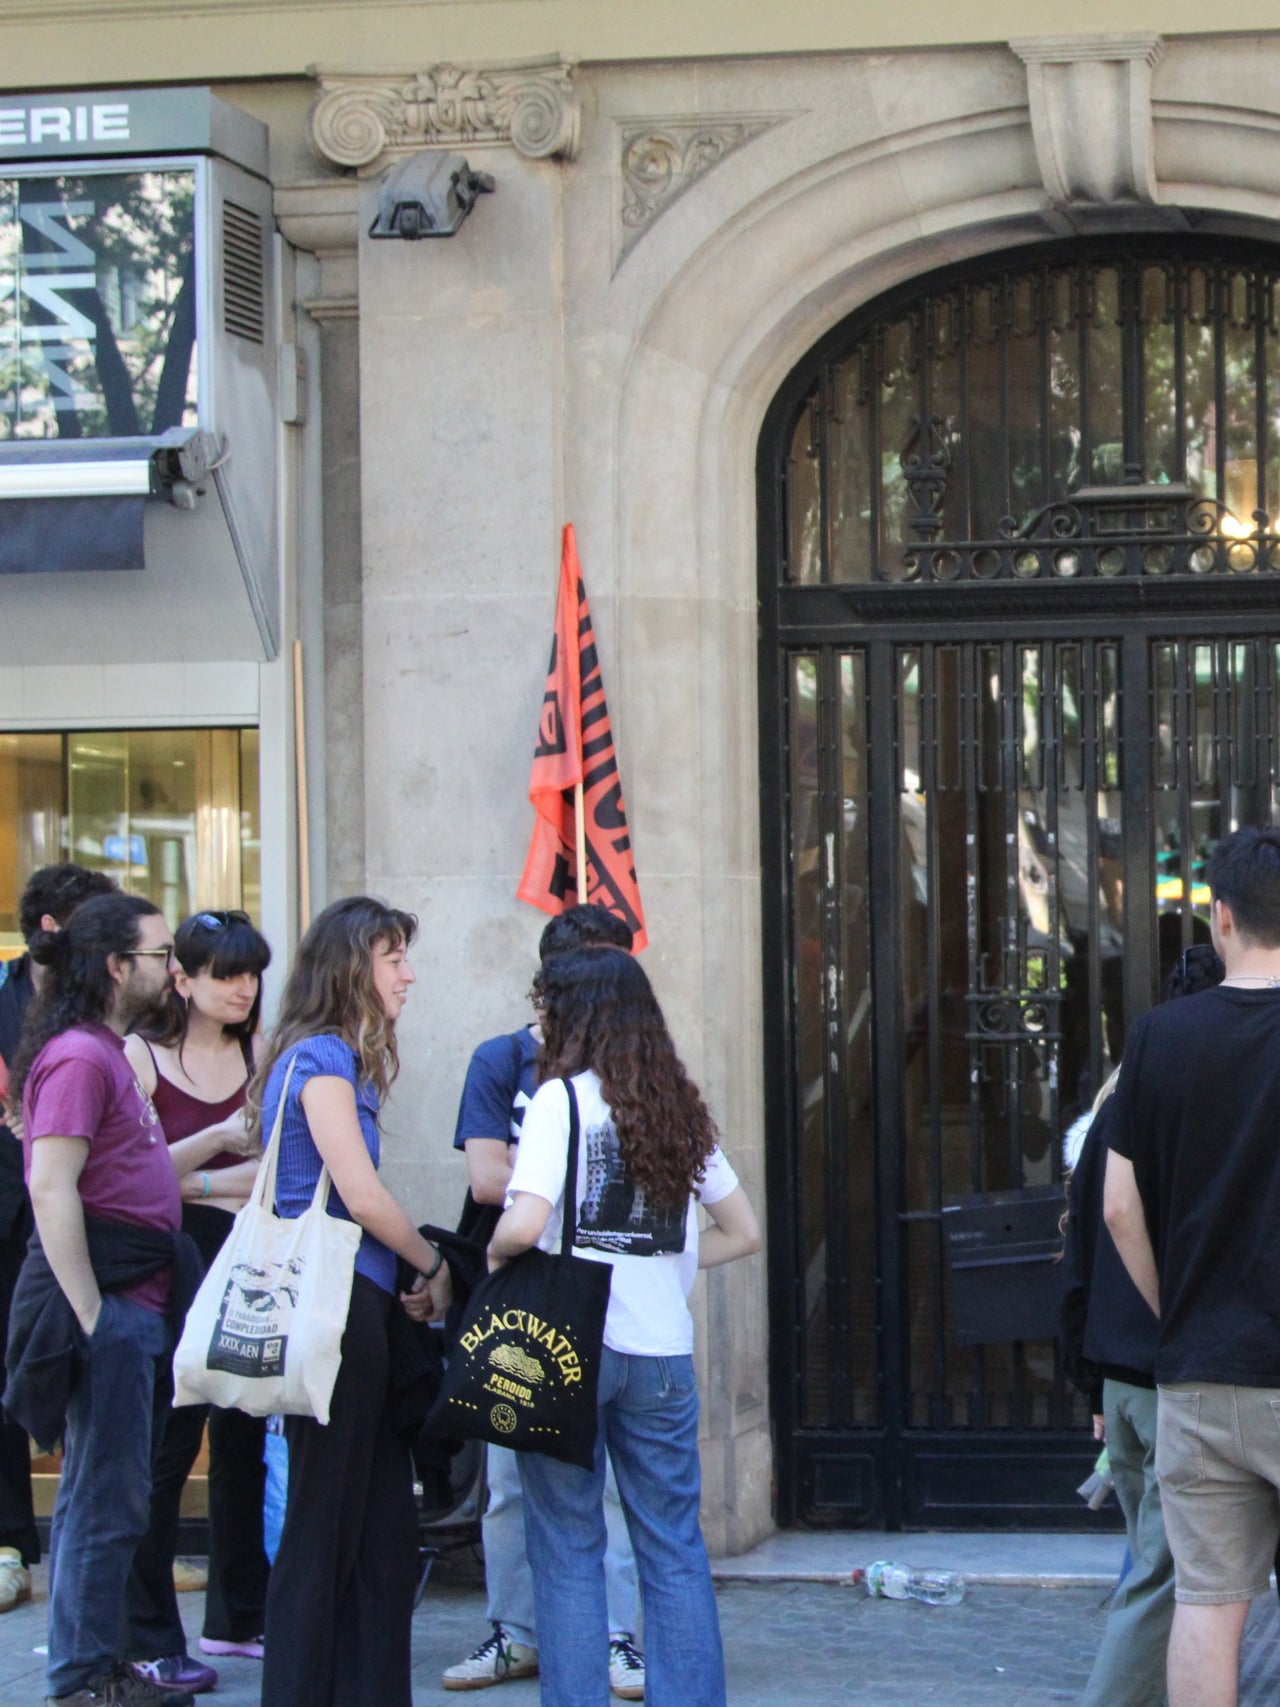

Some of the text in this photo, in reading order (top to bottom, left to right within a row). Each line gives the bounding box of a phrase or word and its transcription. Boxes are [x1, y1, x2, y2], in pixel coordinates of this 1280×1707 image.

[219, 1333, 240, 1352] XXIX
[240, 1343, 259, 1358] AEN
[460, 1309, 582, 1386] BLACKWATER
[490, 1373, 532, 1400] PERDIDO
